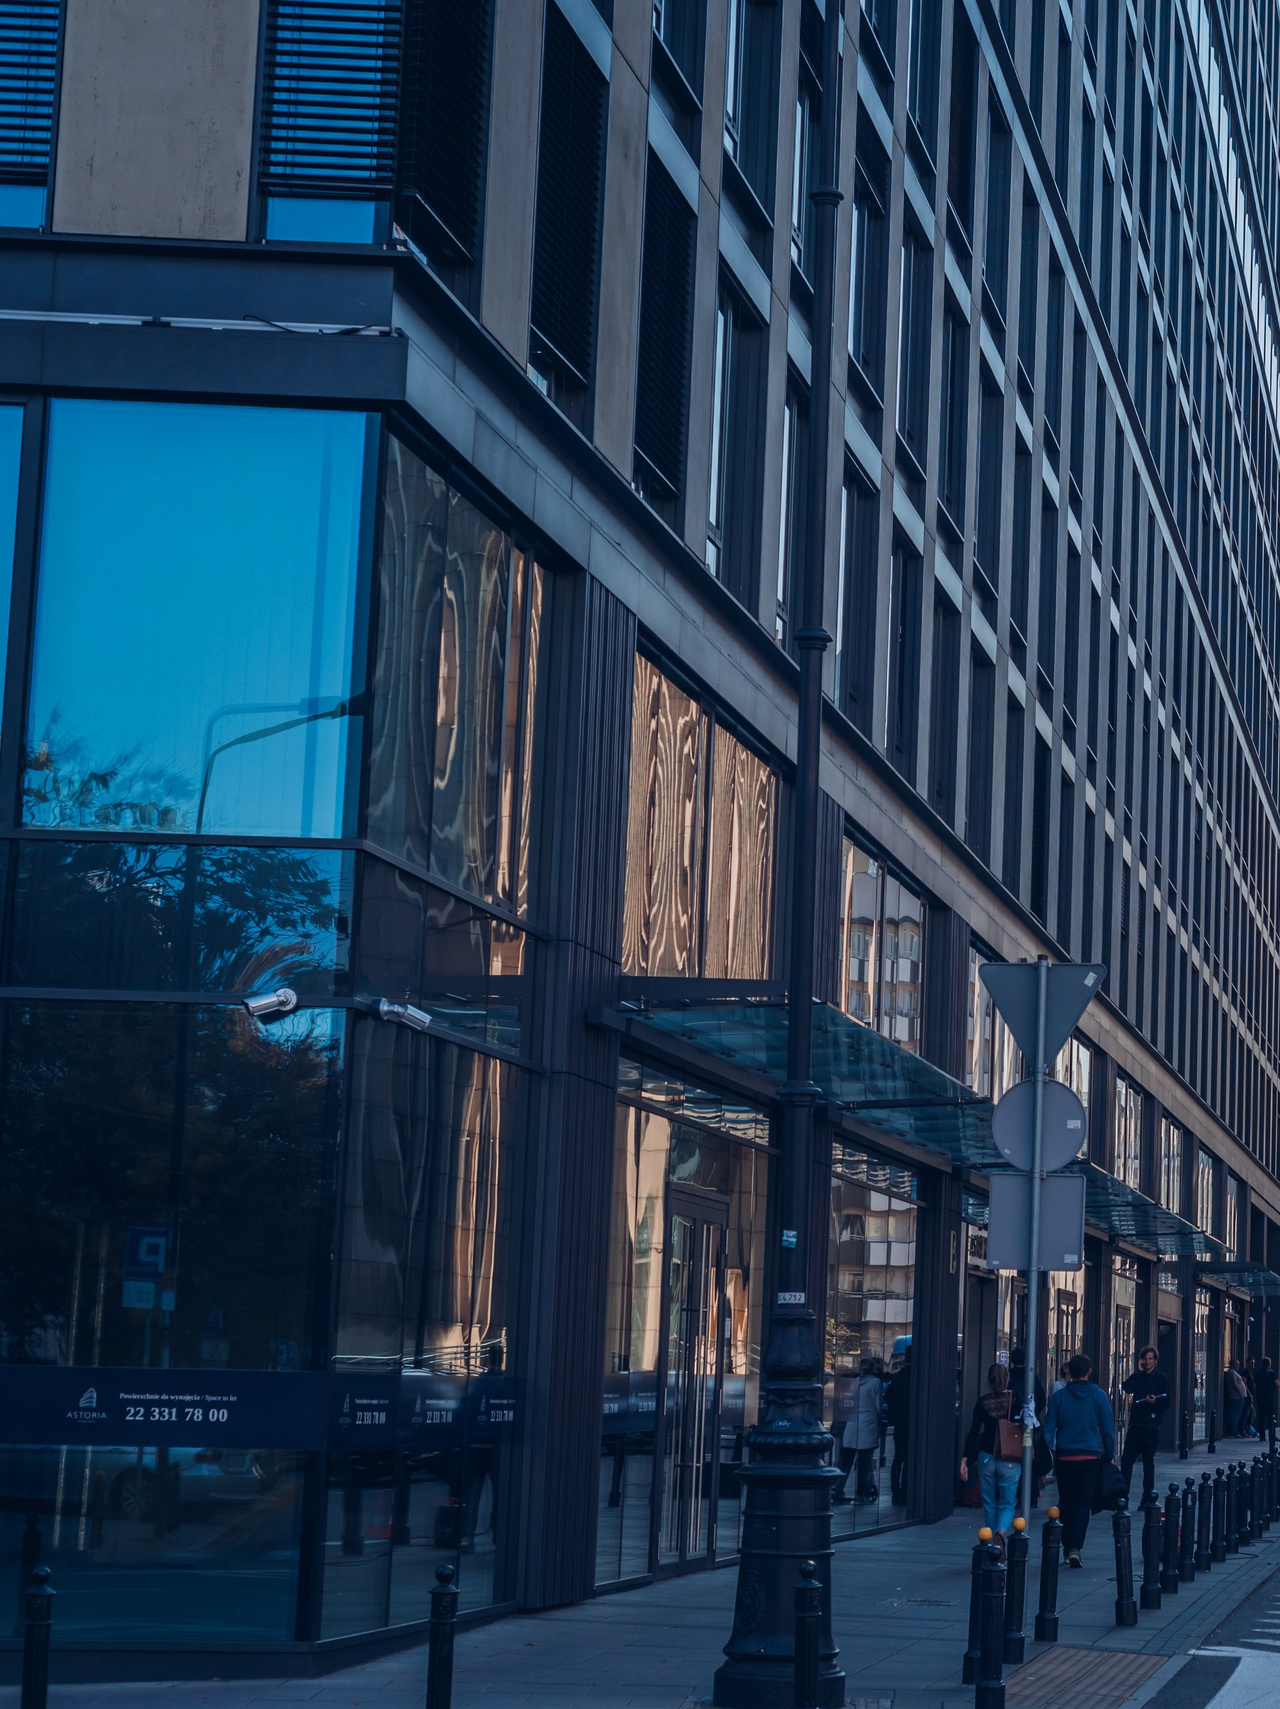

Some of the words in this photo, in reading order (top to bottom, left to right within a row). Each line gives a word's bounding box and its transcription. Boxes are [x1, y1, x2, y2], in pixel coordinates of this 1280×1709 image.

[950, 1230, 957, 1274] B
[66, 1411, 107, 1419] ASTORIA
[125, 1406, 145, 1420] 22
[150, 1407, 178, 1421] 331
[184, 1408, 203, 1421] 78
[208, 1408, 228, 1422] 00
